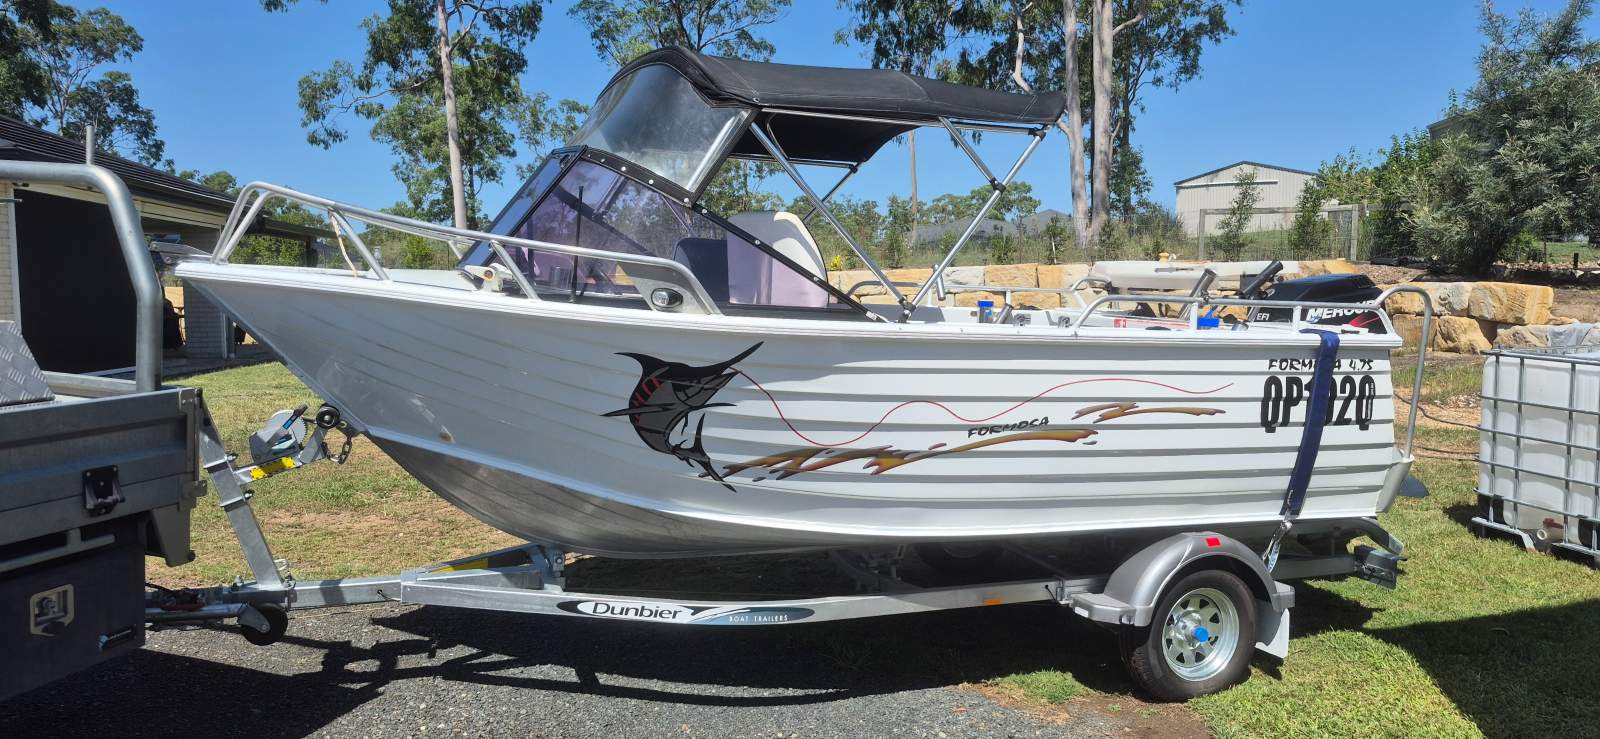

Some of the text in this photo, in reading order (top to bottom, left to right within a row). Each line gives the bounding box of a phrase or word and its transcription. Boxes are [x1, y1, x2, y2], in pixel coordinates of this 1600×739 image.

[1256, 312, 1270, 321] EFI
[1306, 300, 1377, 321] MERCUR
[1268, 358, 1374, 371] FORMA 4.75
[967, 416, 1050, 438] FORMOSA
[592, 602, 683, 619] Dunbier
[729, 614, 789, 623] BOAT TRAILERS
